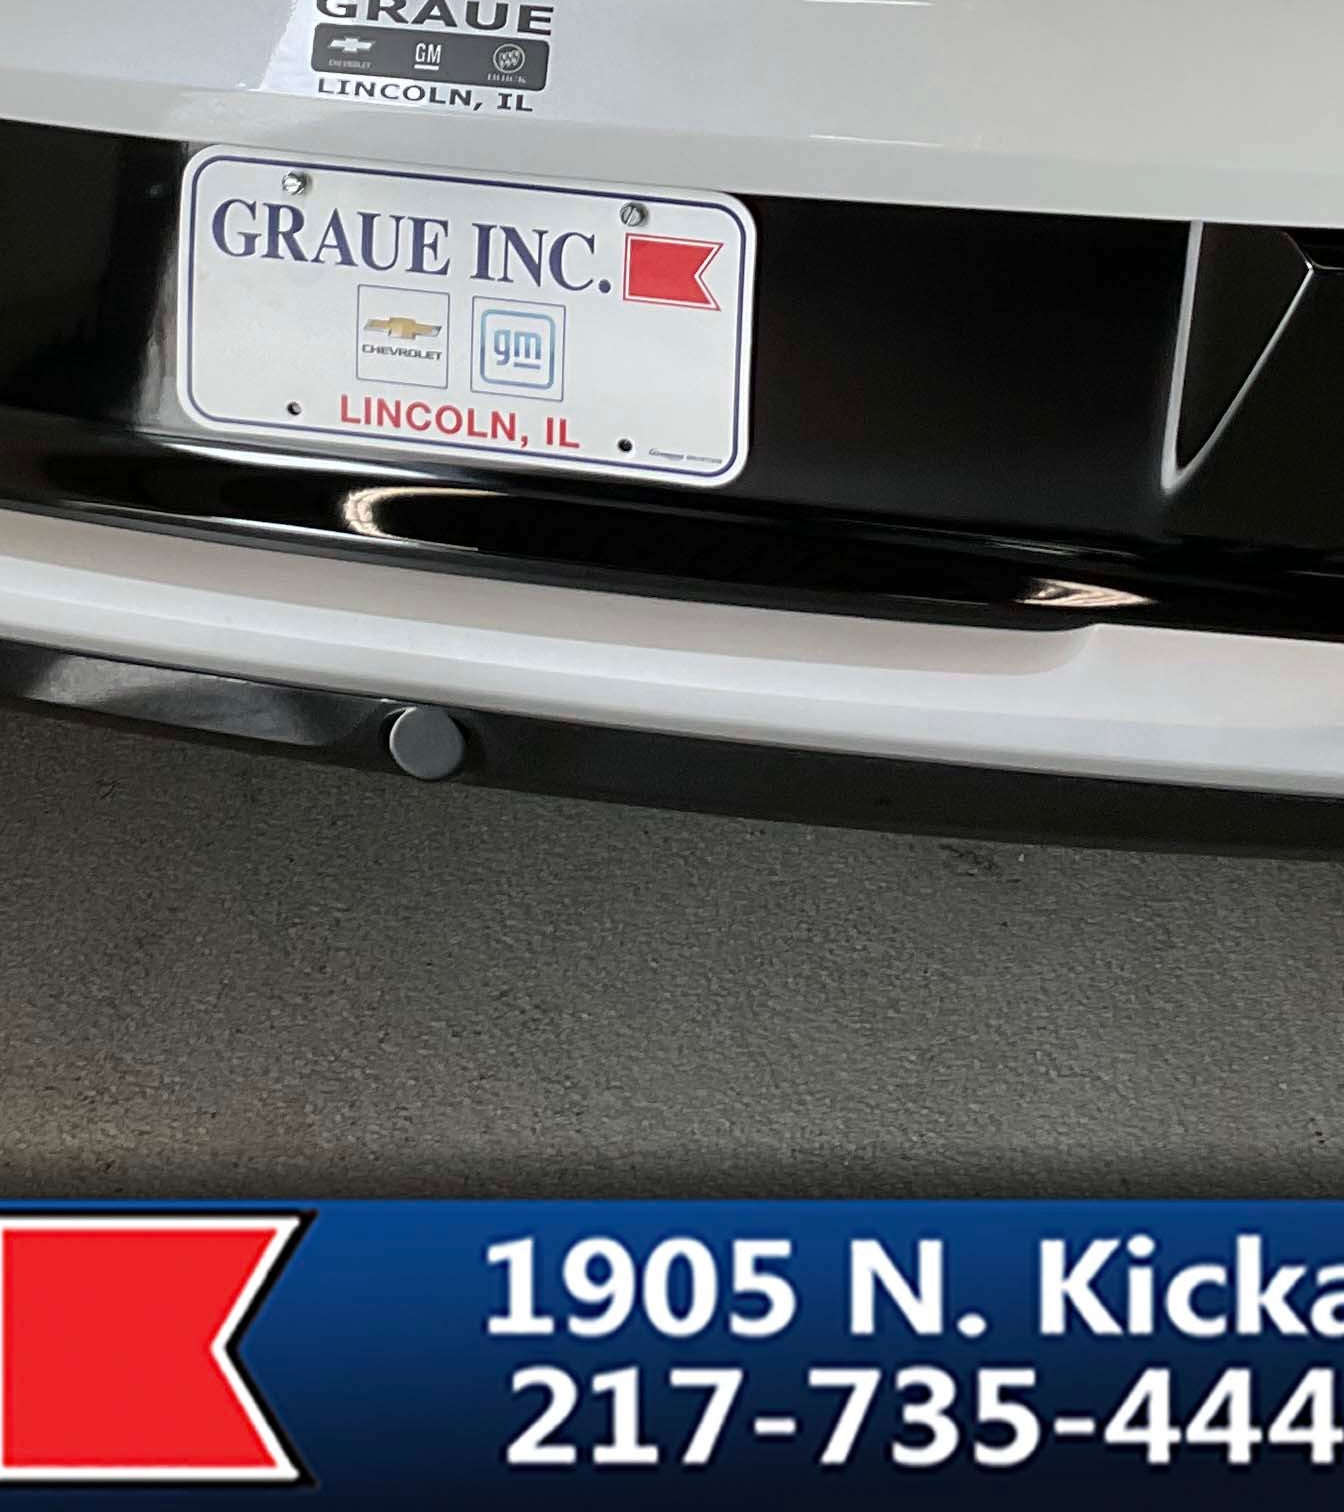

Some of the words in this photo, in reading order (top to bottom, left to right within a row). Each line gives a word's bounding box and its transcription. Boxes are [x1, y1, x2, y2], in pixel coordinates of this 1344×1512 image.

[415, 42, 441, 64] GM
[317, 78, 484, 112] LINCOLN,
[496, 92, 534, 113] IL
[211, 198, 450, 276] GRAUE
[469, 223, 612, 294] INC.
[361, 343, 443, 361] CHEVROLET
[493, 328, 542, 366] gm
[340, 393, 529, 449] LINCOLN,
[546, 417, 581, 449] IL
